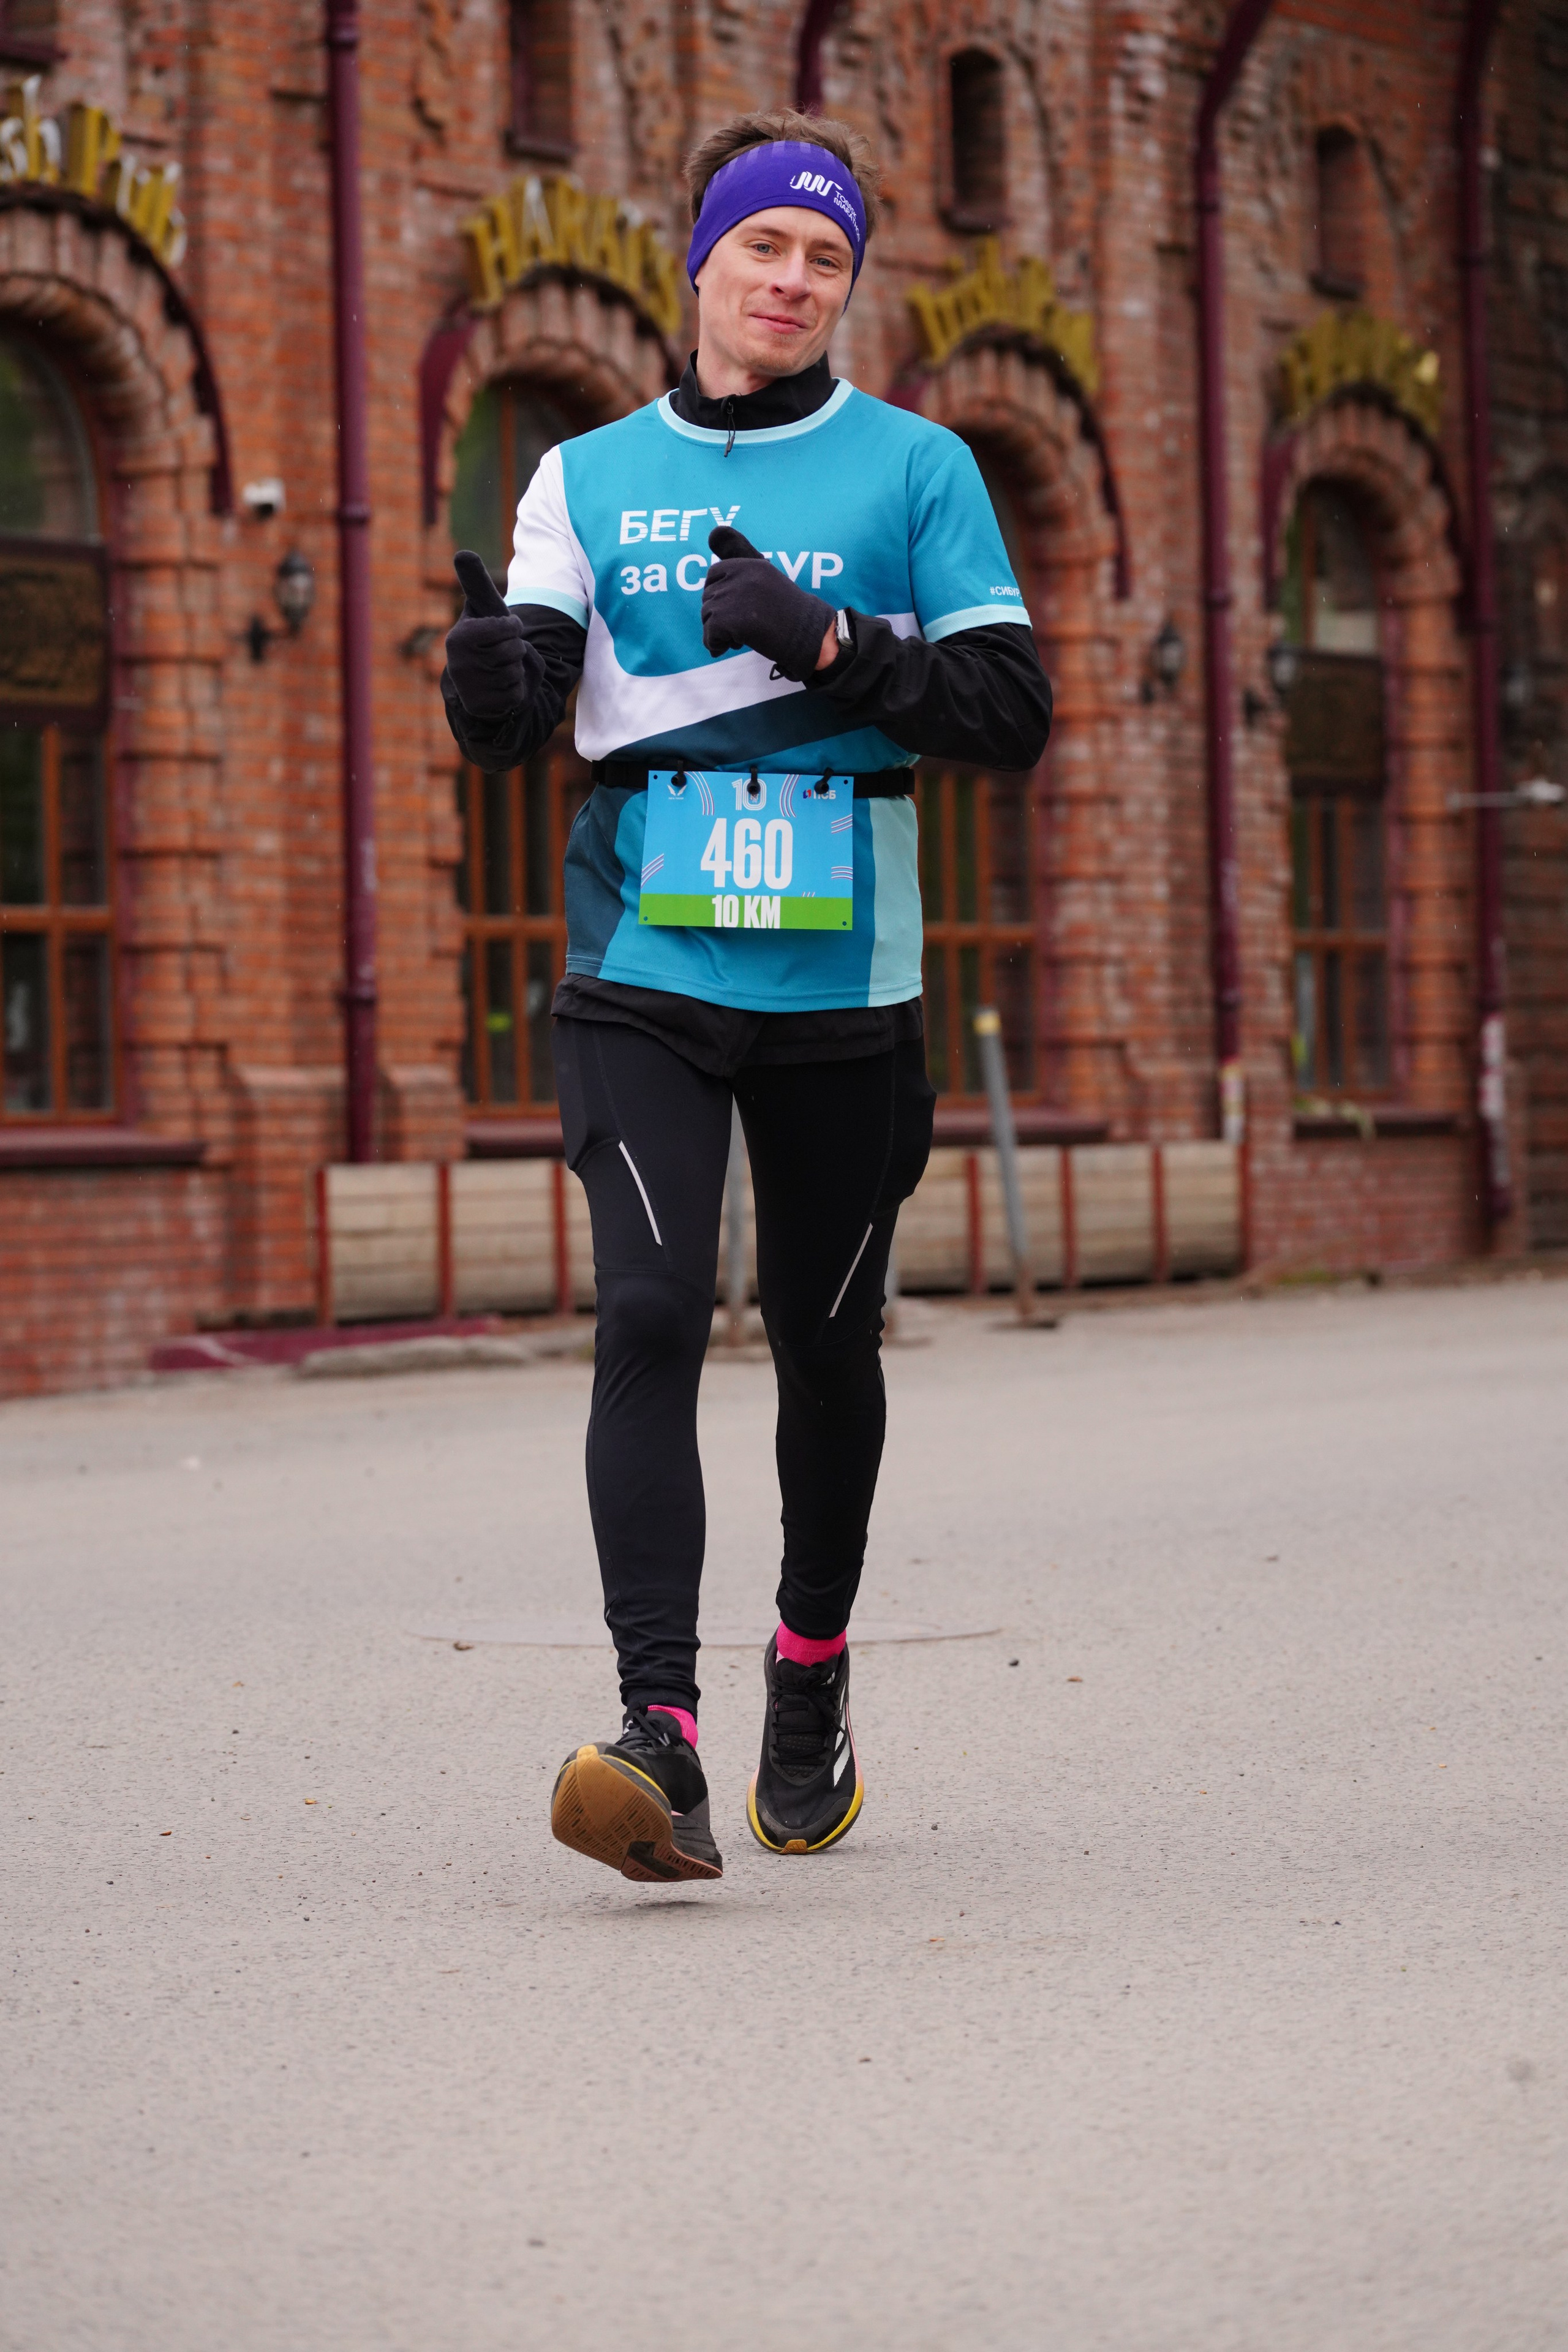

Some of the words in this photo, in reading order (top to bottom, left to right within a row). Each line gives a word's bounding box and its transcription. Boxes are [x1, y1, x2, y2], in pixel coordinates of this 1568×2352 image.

[835, 190, 857, 219] TOMSK
[619, 505, 741, 545] БЕГУ
[620, 563, 668, 595] за
[676, 551, 844, 592] СУР
[731, 778, 767, 811] 10
[700, 818, 793, 889] 460
[712, 894, 739, 928] 10
[744, 895, 781, 929] KM
